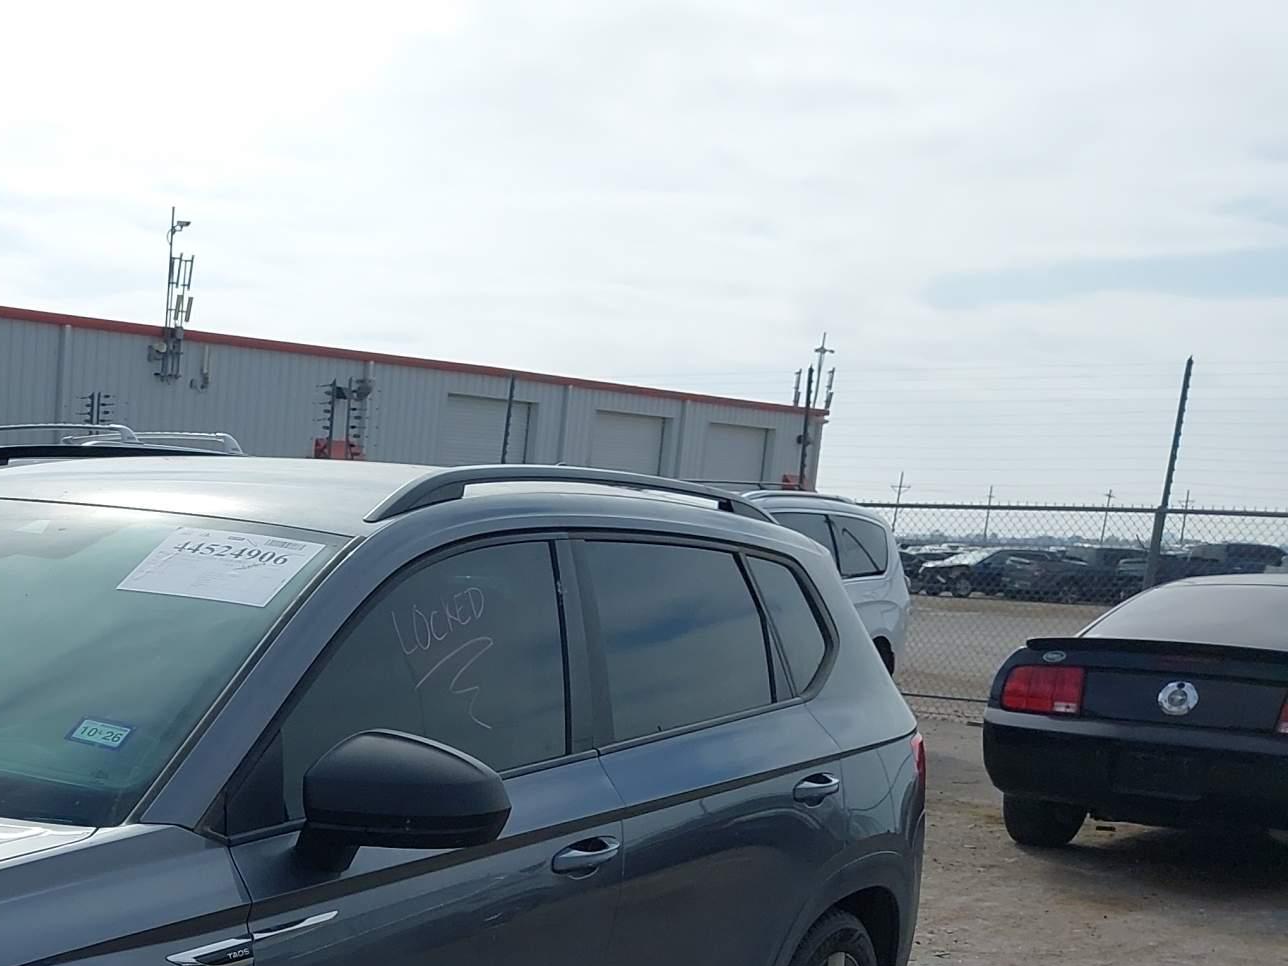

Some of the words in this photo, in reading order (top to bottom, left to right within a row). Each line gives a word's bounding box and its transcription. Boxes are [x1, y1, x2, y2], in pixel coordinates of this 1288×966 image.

[173, 541, 289, 565] 44524906
[391, 586, 485, 655] LOCKED
[226, 948, 250, 960] TAOS
